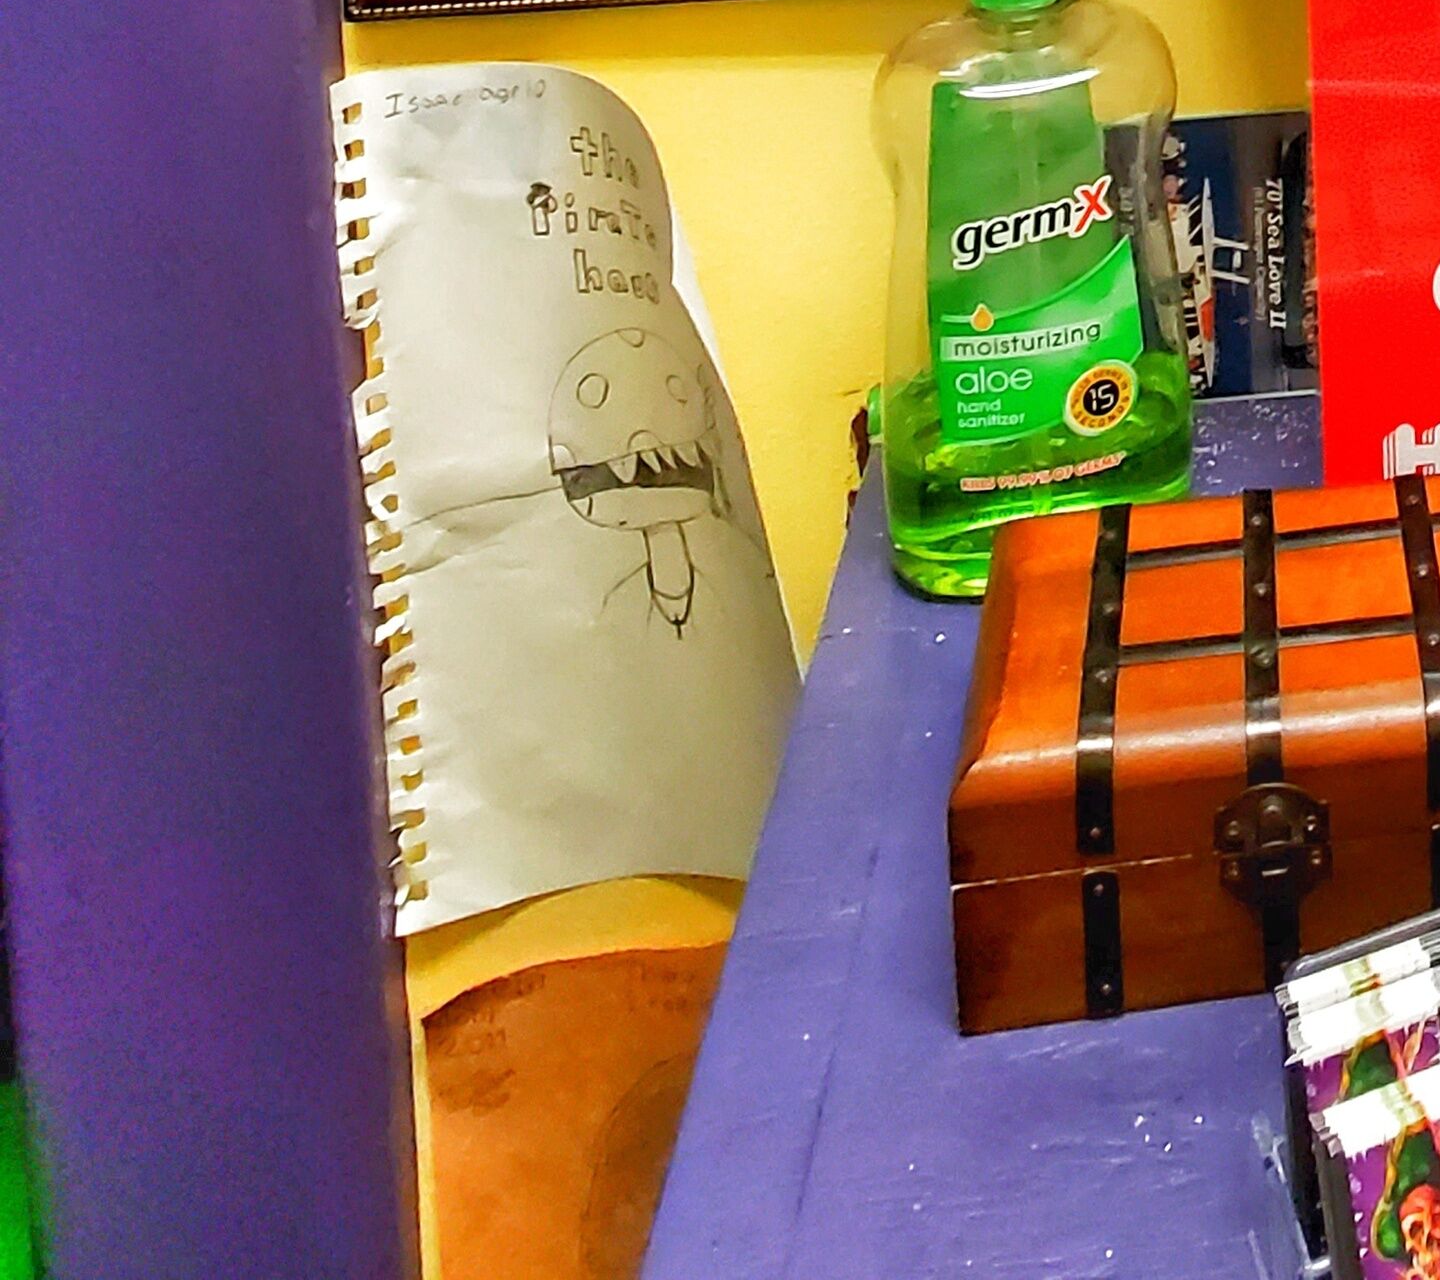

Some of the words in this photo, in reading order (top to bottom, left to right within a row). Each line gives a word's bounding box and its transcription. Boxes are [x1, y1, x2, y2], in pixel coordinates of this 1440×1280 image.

[1266, 212, 1284, 250] Sea
[1267, 254, 1285, 306] Love
[953, 321, 1102, 357] moisturizing
[954, 363, 1034, 396] aloe
[956, 398, 1002, 413] hand
[1088, 383, 1115, 412] 15
[957, 410, 1026, 428] sanitizer
